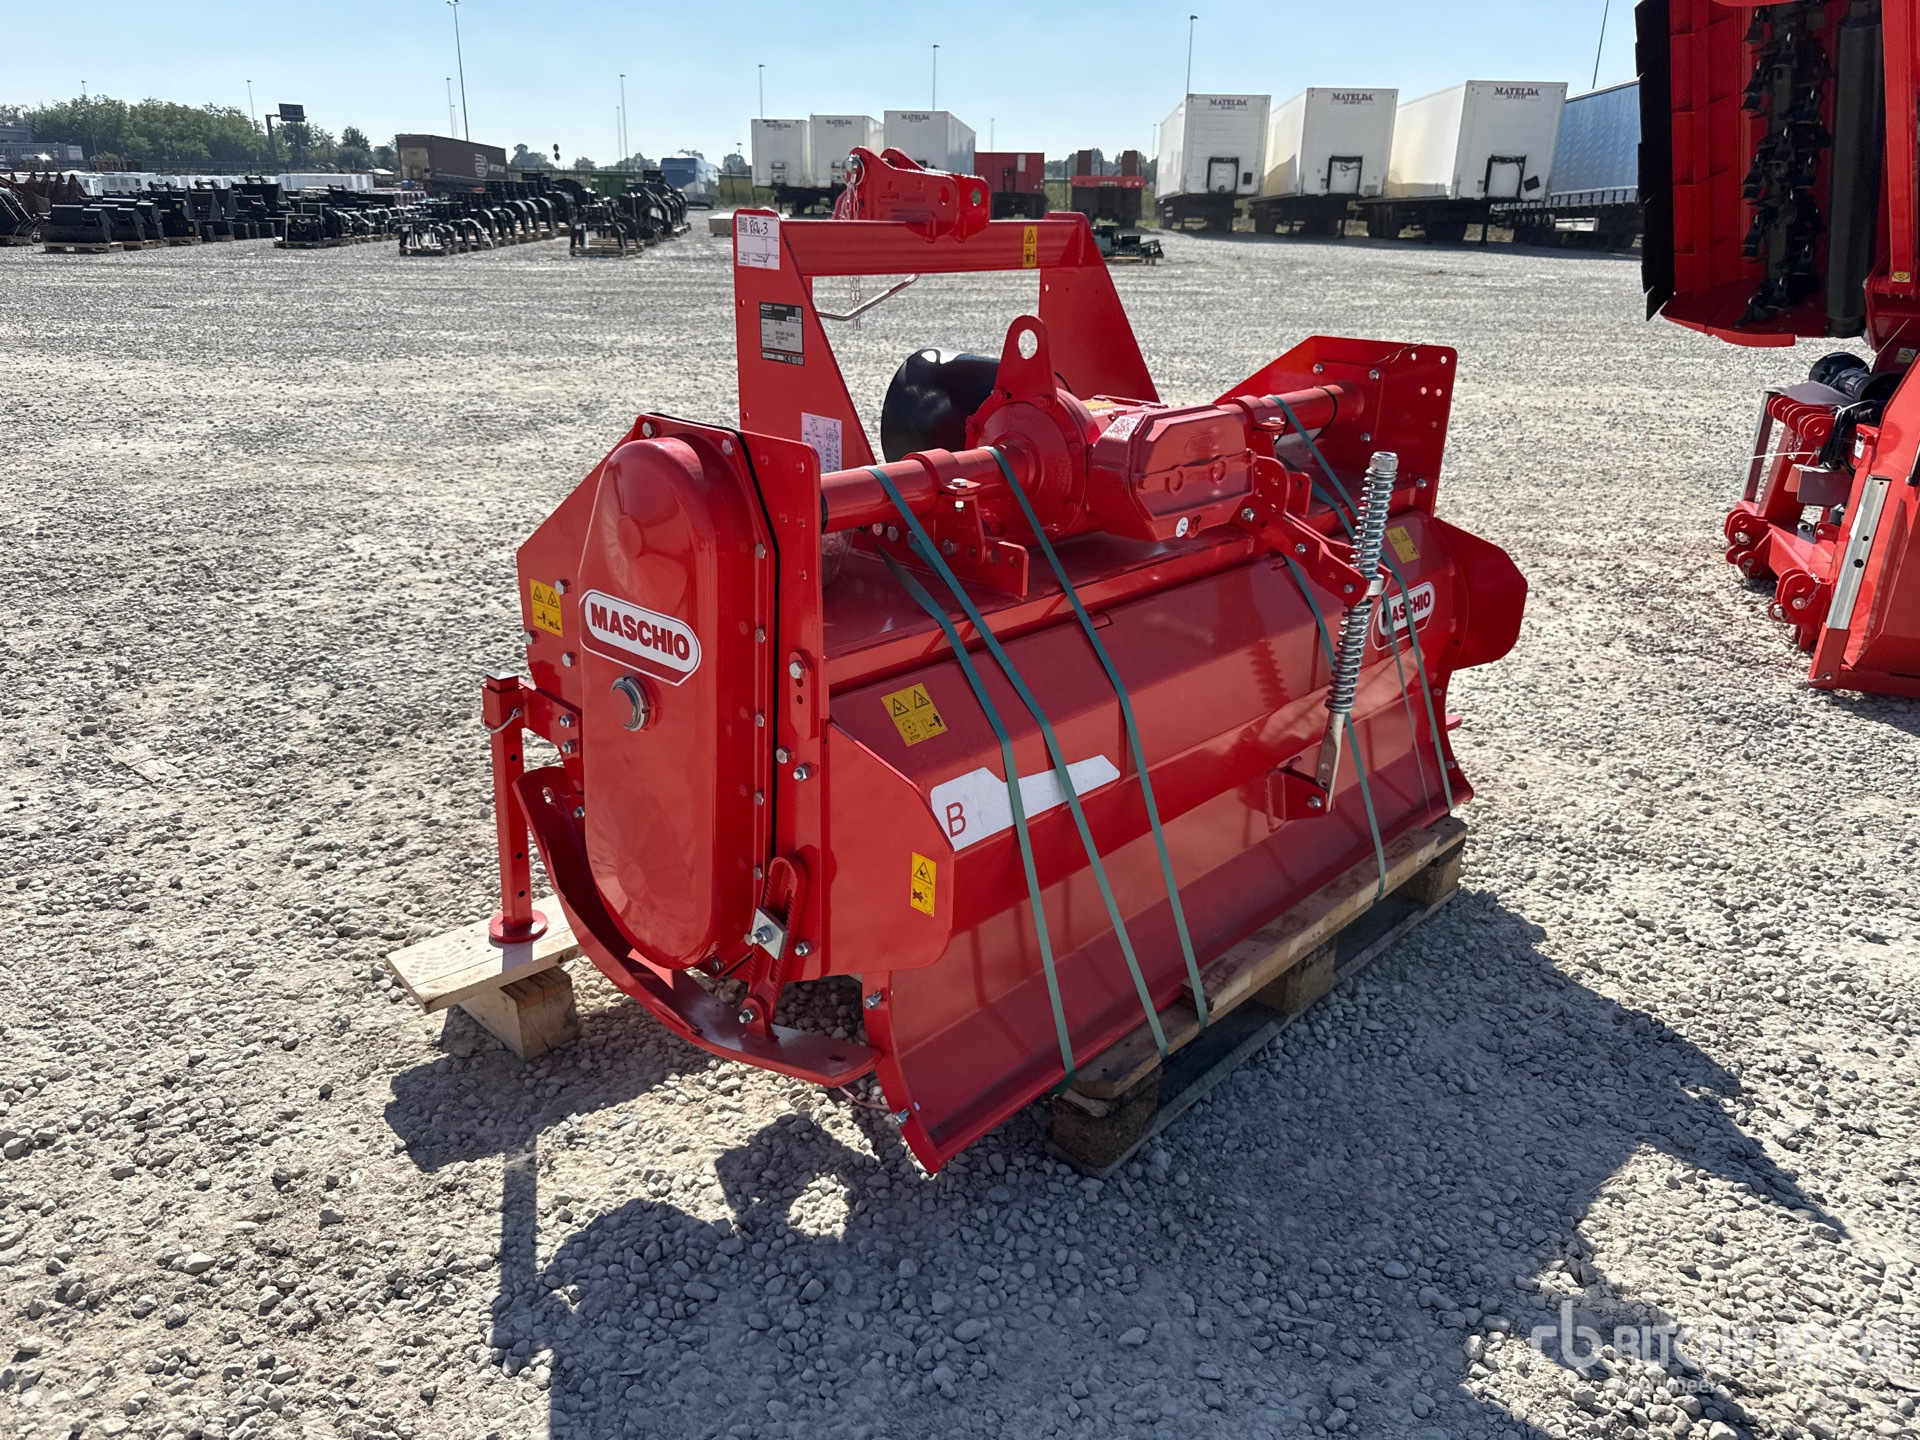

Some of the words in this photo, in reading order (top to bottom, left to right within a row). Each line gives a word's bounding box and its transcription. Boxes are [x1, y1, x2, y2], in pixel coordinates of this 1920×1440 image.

[1494, 86, 1539, 96] MATELDA
[1209, 98, 1247, 106] MATELDA
[1332, 93, 1373, 101] MATELDA
[590, 602, 690, 660] MASCHIO
[945, 802, 967, 838] B
